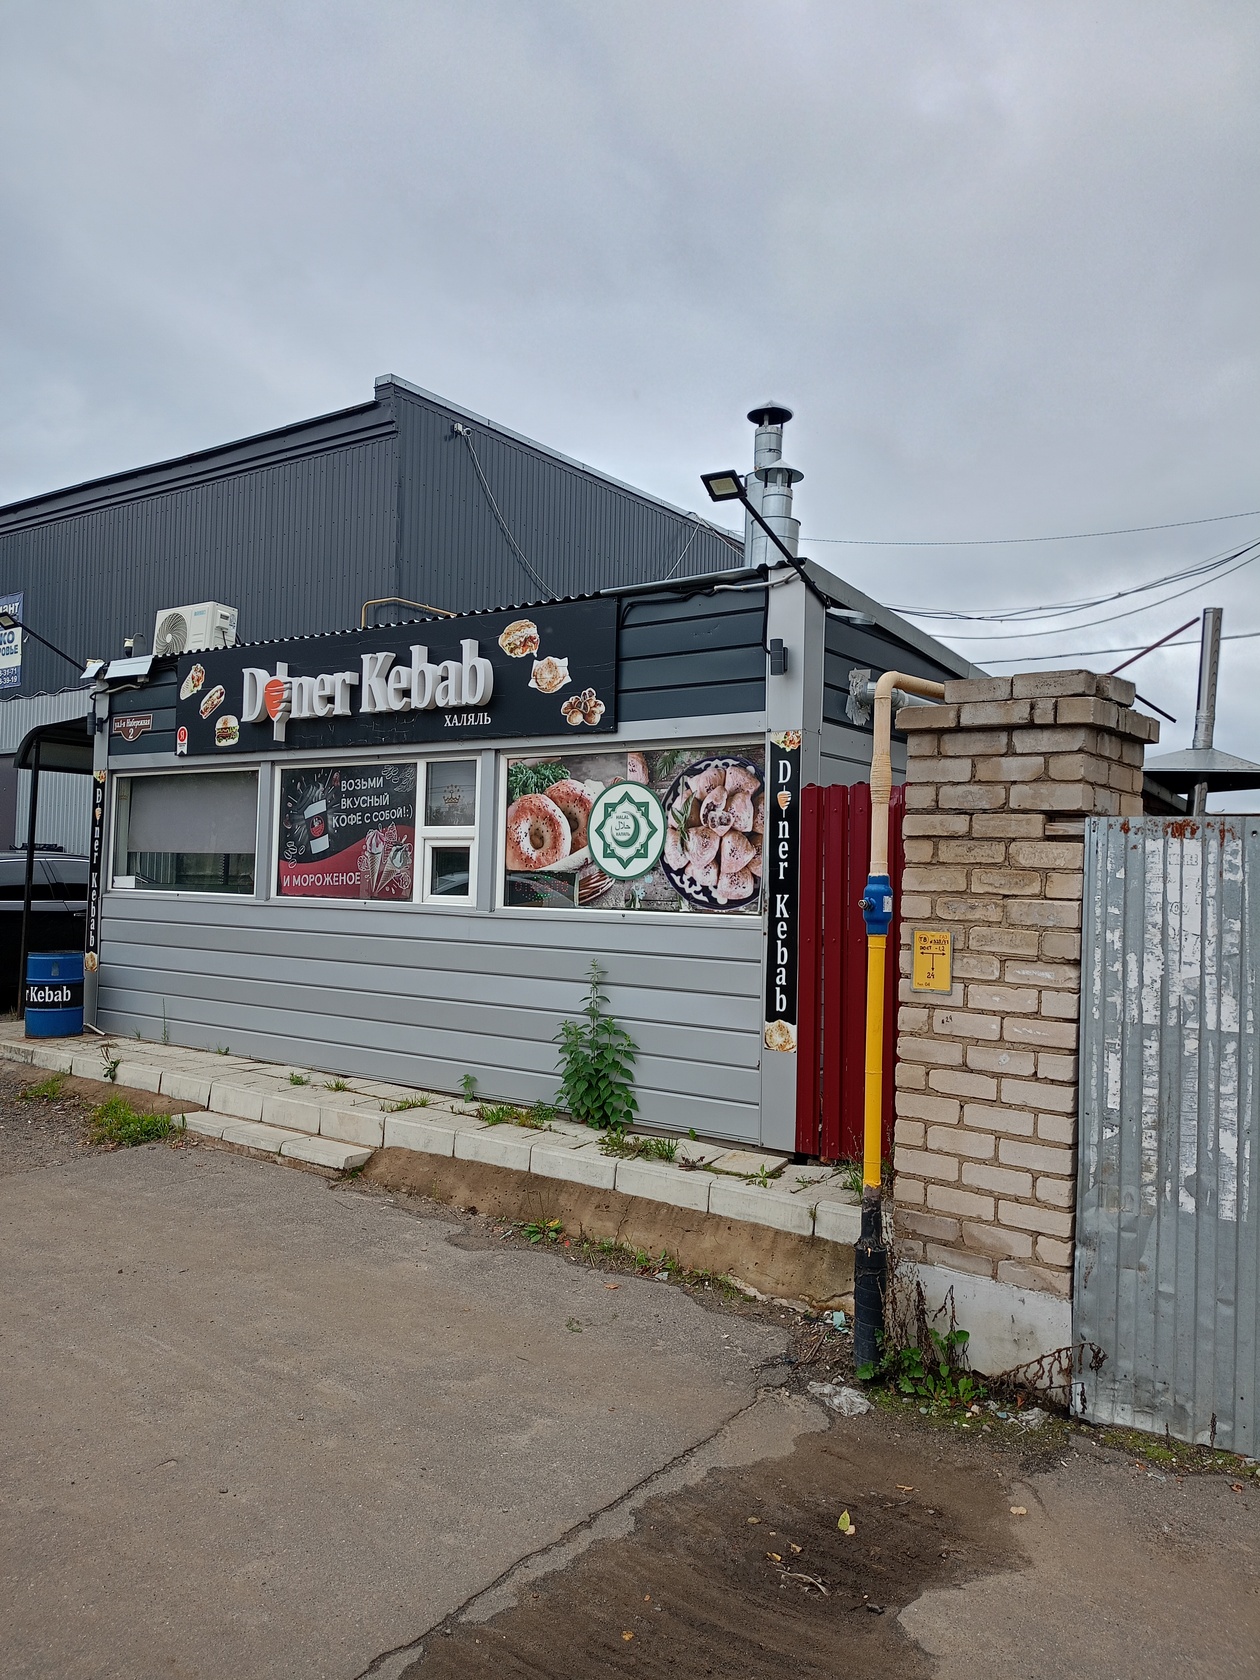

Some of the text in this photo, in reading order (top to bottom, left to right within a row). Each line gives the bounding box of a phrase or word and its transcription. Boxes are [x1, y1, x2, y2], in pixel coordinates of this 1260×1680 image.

[359, 639, 494, 714] Kebab
[444, 712, 492, 727] ХАЛЯЛЬ
[128, 728, 134, 739] 2
[340, 776, 384, 792] ВОЗЬМИ
[340, 793, 390, 810] ВКУСНЫЙ
[332, 812, 362, 828] КОФЕ
[365, 812, 371, 823] С
[283, 872, 361, 887] И МОРОЖЕНОЕ
[774, 893, 790, 1013] Kebab
[926, 971, 935, 979] 24
[30, 985, 71, 1002] Kebab
